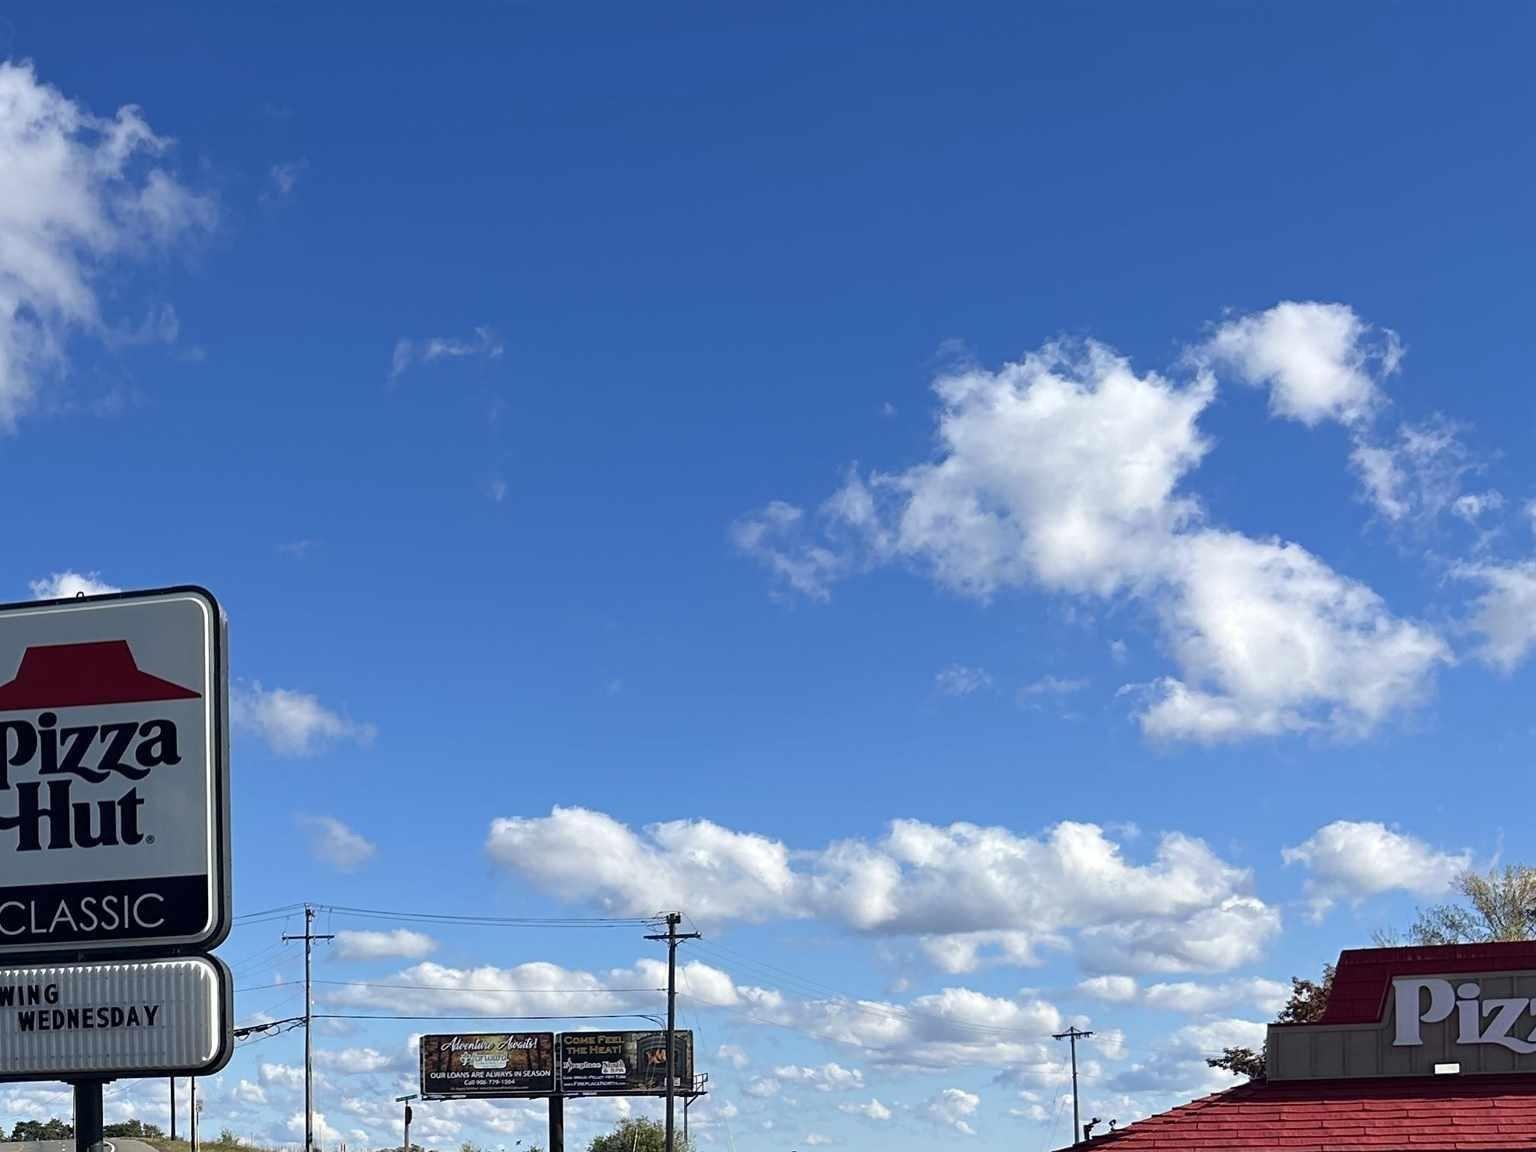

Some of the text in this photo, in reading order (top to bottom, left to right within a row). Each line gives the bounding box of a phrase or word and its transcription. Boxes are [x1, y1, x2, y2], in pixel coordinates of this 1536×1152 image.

[17, 1004, 160, 1032] WEDNESDAY
[1392, 978, 1536, 1054] Piz
[440, 1036, 495, 1052] Adventure
[564, 1035, 625, 1045] COME FEEL
[566, 1046, 588, 1055] THE
[430, 1071, 446, 1079] OUR
[447, 1071, 470, 1079] LOANS
[485, 1070, 513, 1078] ALWAYS
